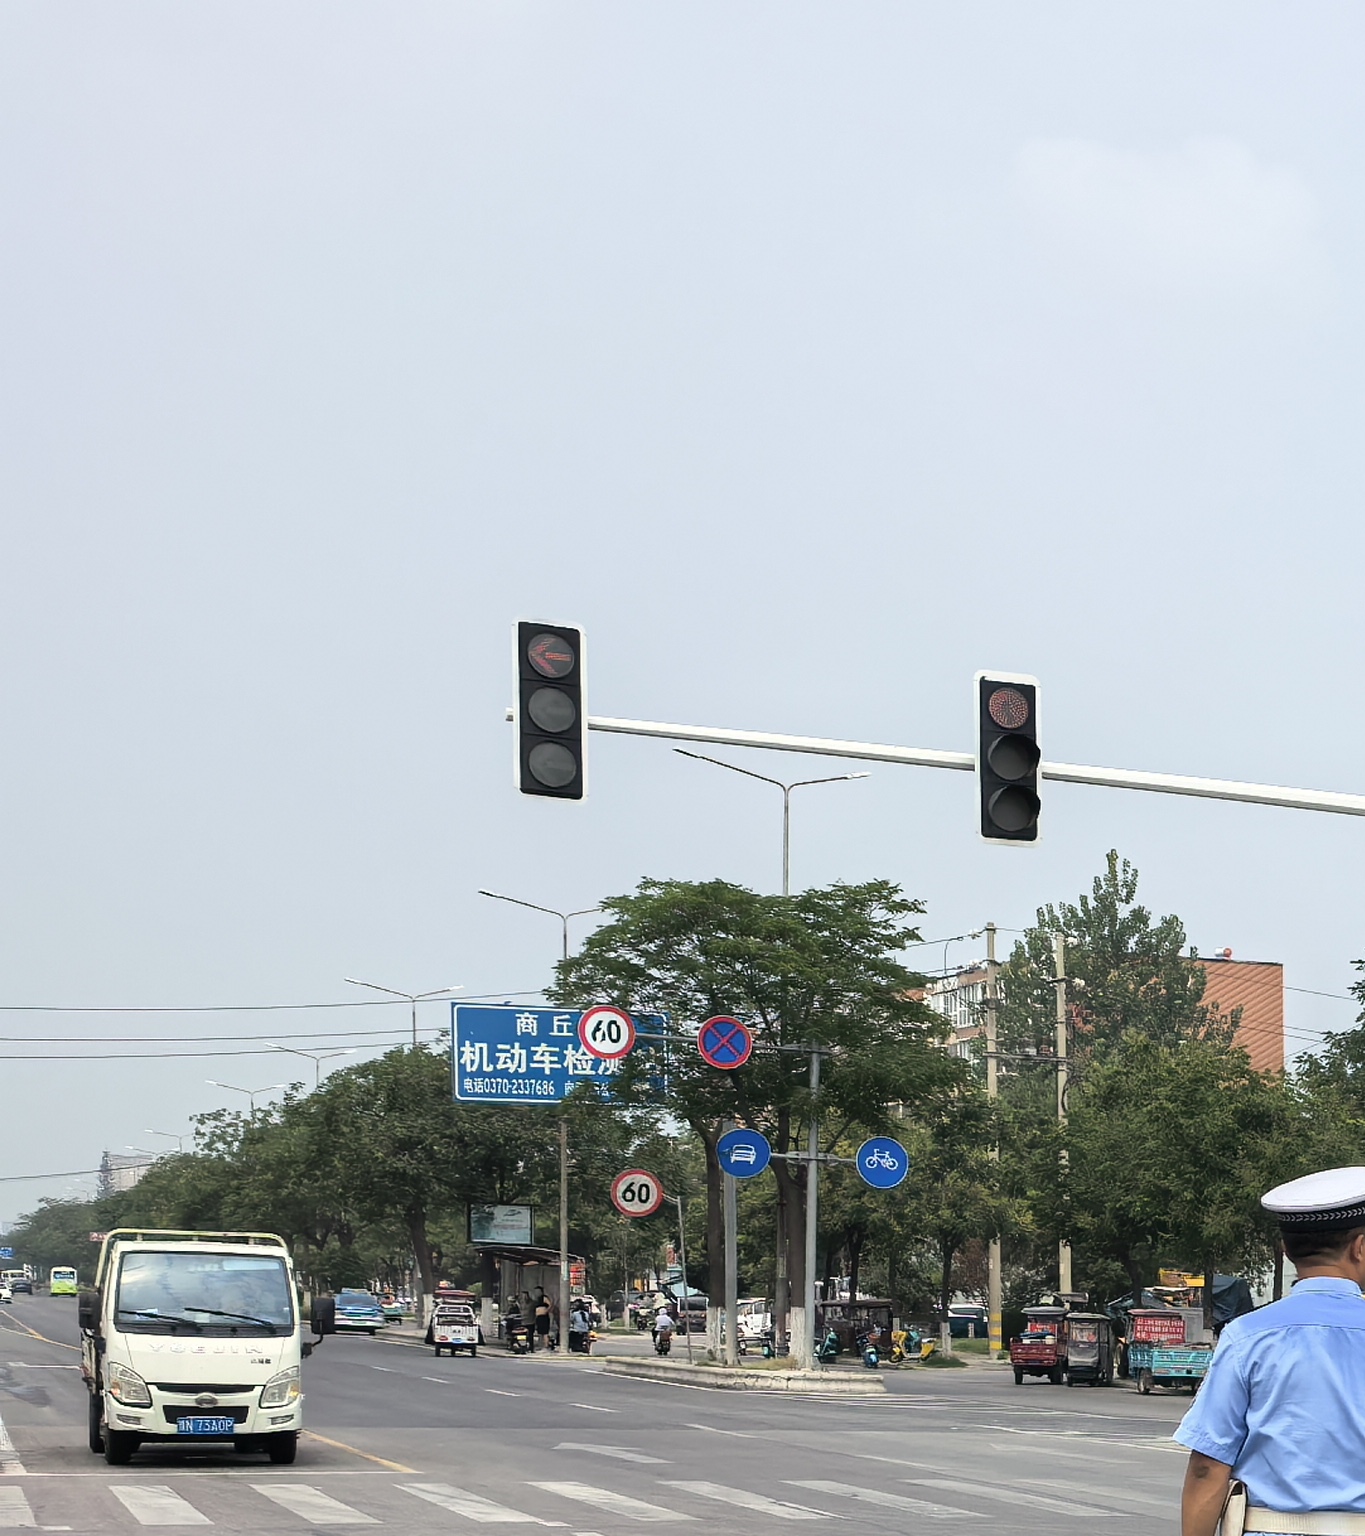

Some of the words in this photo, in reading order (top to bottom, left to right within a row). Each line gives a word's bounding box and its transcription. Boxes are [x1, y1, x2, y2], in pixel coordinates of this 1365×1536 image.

[515, 1012, 574, 1037] 商丘
[591, 1020, 621, 1044] 60
[621, 1181, 651, 1204] 60
